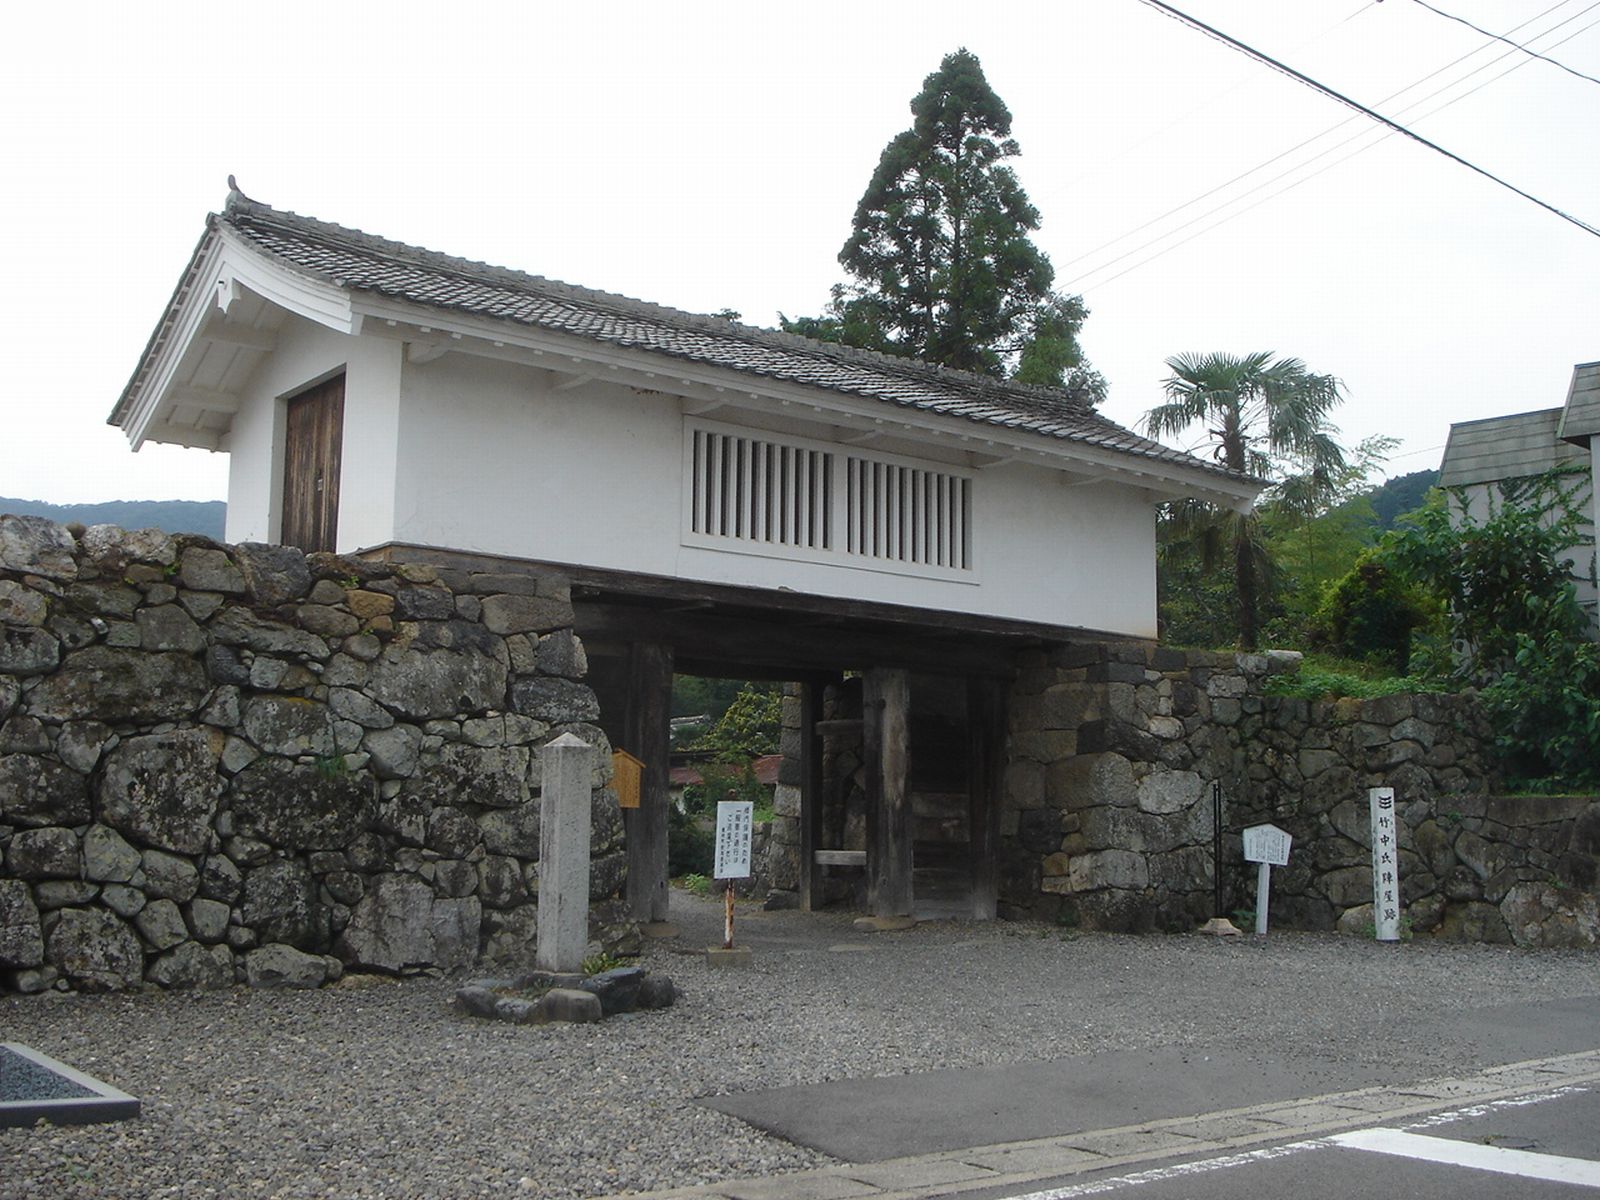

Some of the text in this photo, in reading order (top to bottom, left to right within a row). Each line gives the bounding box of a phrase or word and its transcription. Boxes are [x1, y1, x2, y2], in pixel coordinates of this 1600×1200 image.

[1379, 816, 1396, 921] 竹中氏陣屋跡
